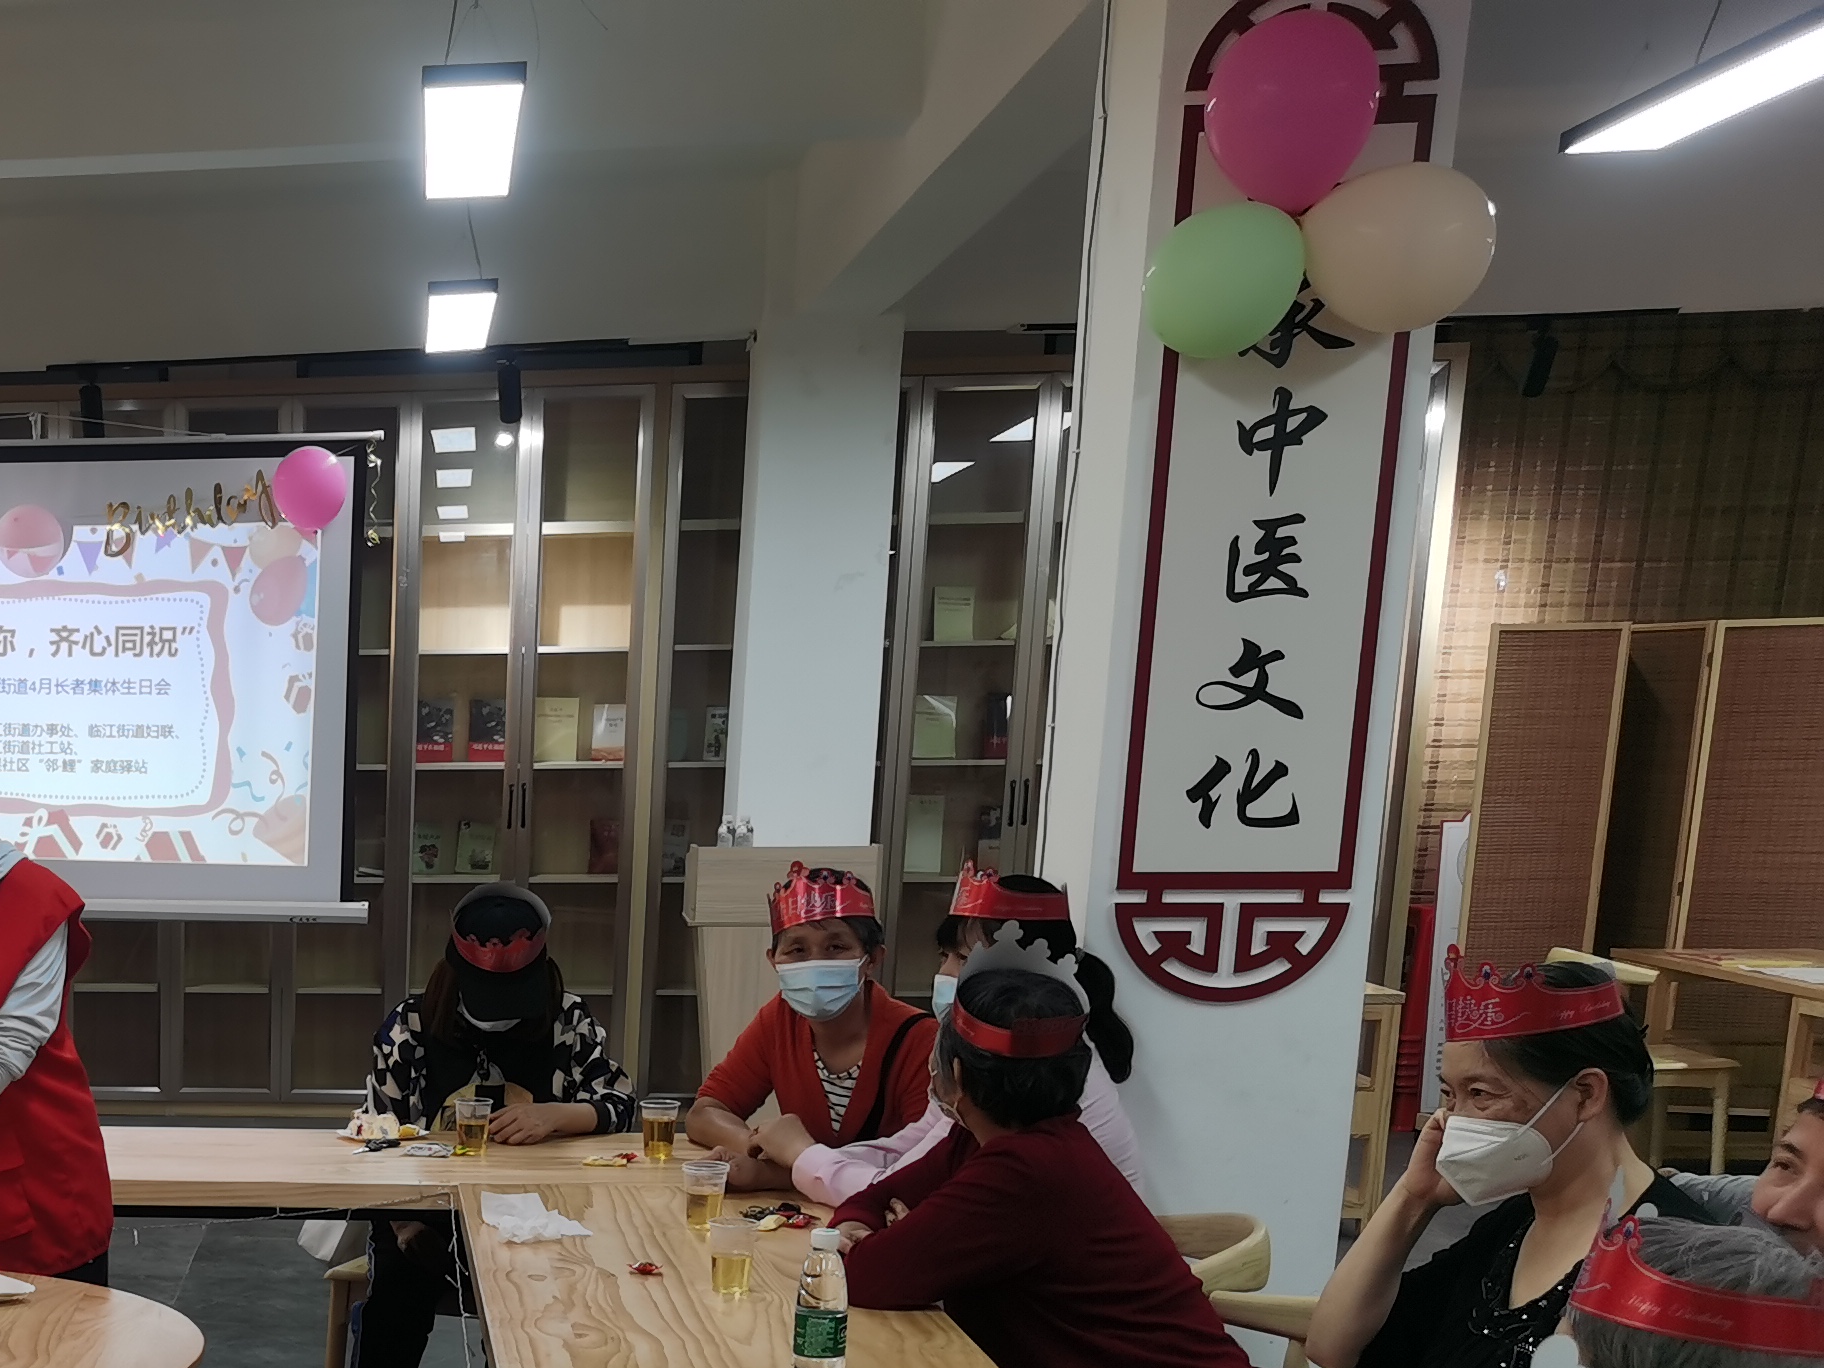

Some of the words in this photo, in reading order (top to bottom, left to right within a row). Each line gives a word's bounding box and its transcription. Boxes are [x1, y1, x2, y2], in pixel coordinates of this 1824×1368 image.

[103, 468, 280, 558] Birthday
[1185, 180, 1356, 832] 承中医文化
